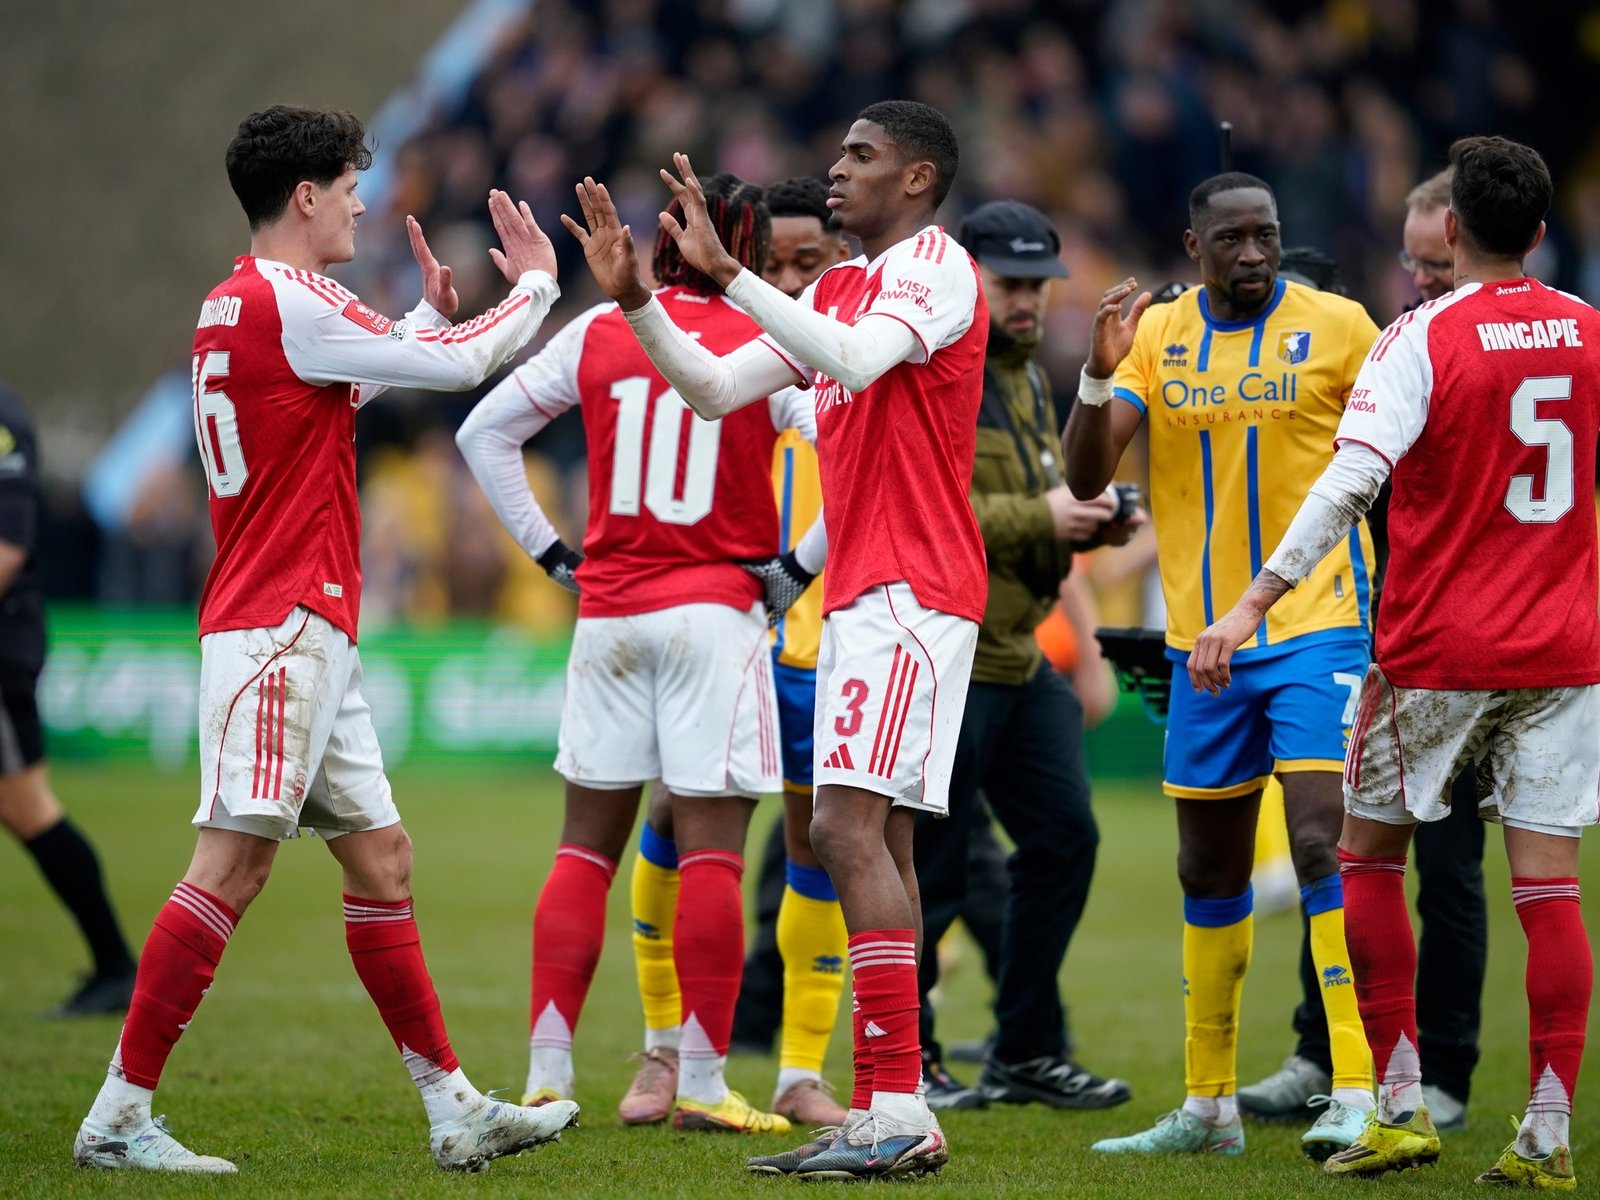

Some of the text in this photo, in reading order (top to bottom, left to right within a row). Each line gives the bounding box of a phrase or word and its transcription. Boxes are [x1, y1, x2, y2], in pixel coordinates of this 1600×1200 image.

[880, 290, 933, 316] RWANDA
[897, 278, 931, 297] VISIT
[1496, 282, 1531, 296] Arsenal
[1476, 318, 1583, 352] HINCAPIE
[1162, 372, 1296, 408] One Call
[1348, 400, 1376, 413] NDA
[1352, 389, 1371, 399] SIT
[191, 350, 249, 501] 16
[1168, 409, 1296, 427] INSURANCE
[609, 376, 722, 526] 10
[1504, 375, 1574, 524] 5
[834, 677, 870, 737] 3
[1333, 672, 1362, 724] 7
